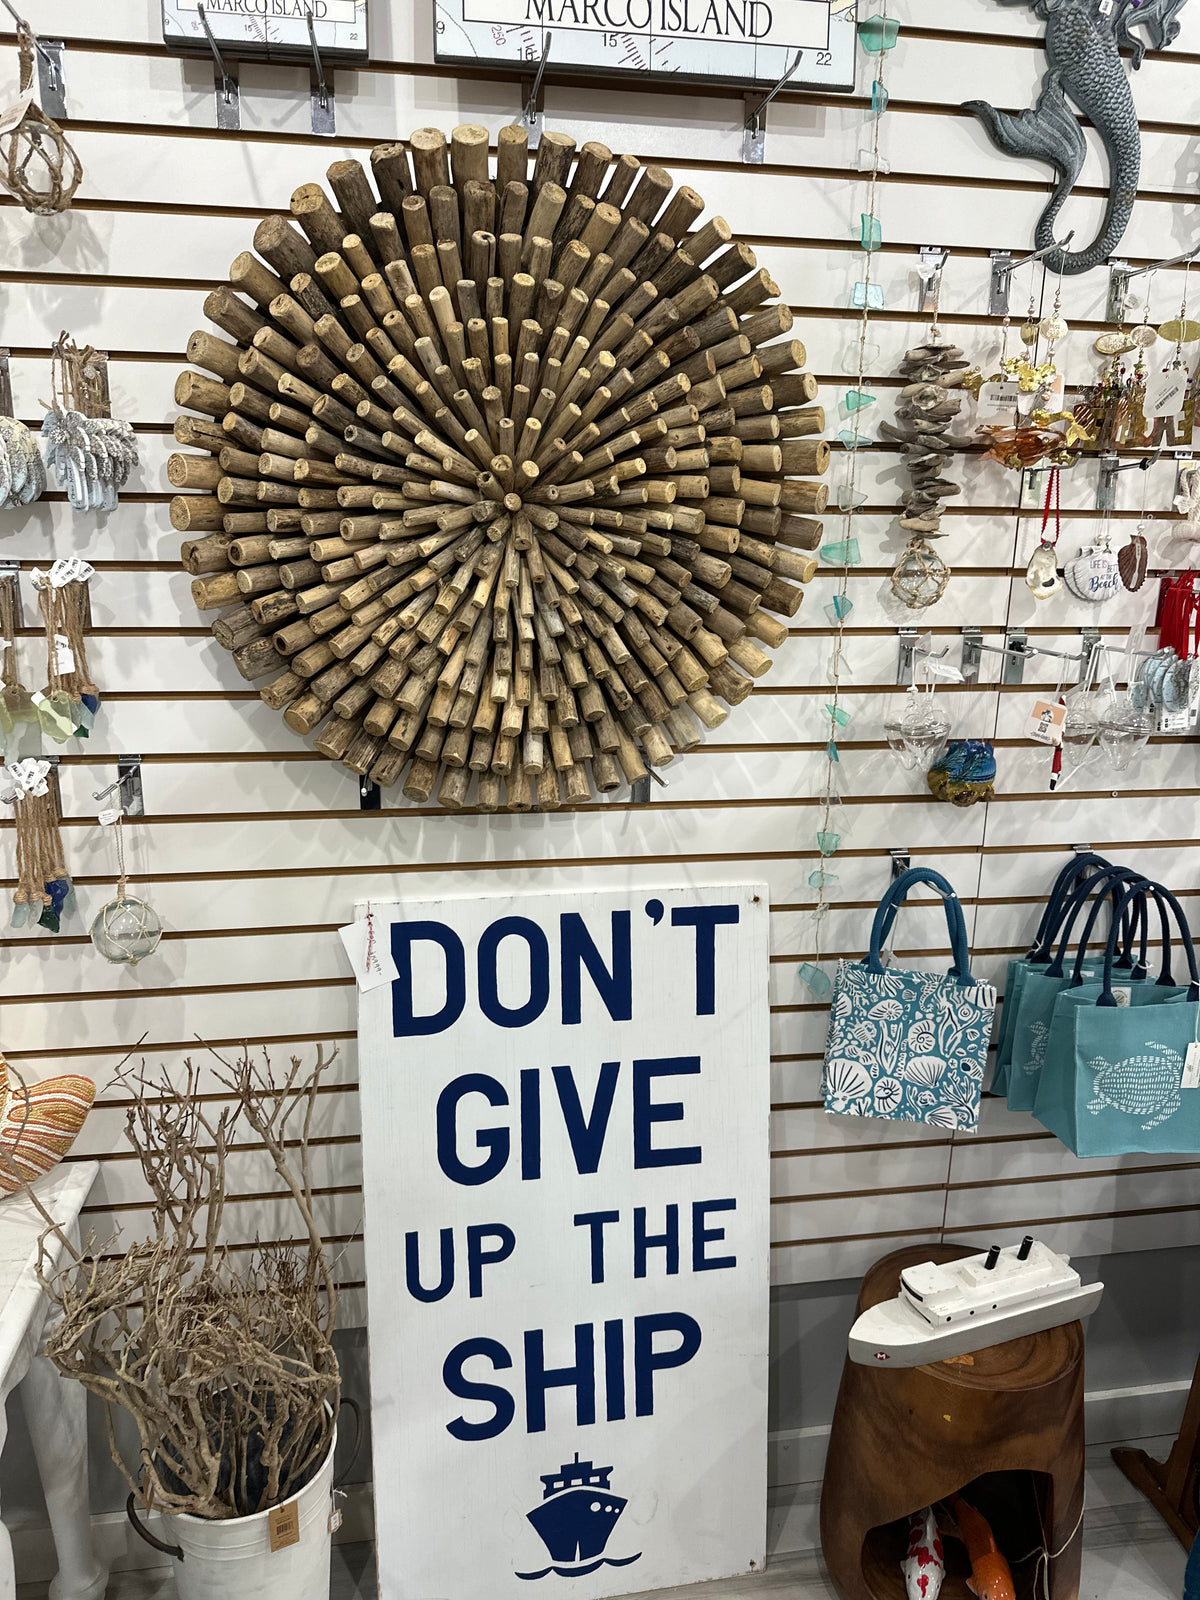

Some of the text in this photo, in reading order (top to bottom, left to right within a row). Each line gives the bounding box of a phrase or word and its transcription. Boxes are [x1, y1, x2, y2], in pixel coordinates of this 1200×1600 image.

[206, 0, 328, 18] MARCO ISLAND
[435, 20, 446, 35] 9
[525, 0, 773, 39] MARCO ISLAND
[349, 33, 359, 41] 22
[491, 24, 507, 46] 250
[602, 32, 618, 48] 15
[816, 52, 833, 67] 22
[1089, 559, 1101, 569] LIFE
[1089, 573, 1119, 593] Beach
[390, 898, 740, 1038] DON'T
[436, 1056, 702, 1186] GIVE
[404, 1198, 737, 1303] UP THE
[442, 1311, 702, 1441] SHIP
